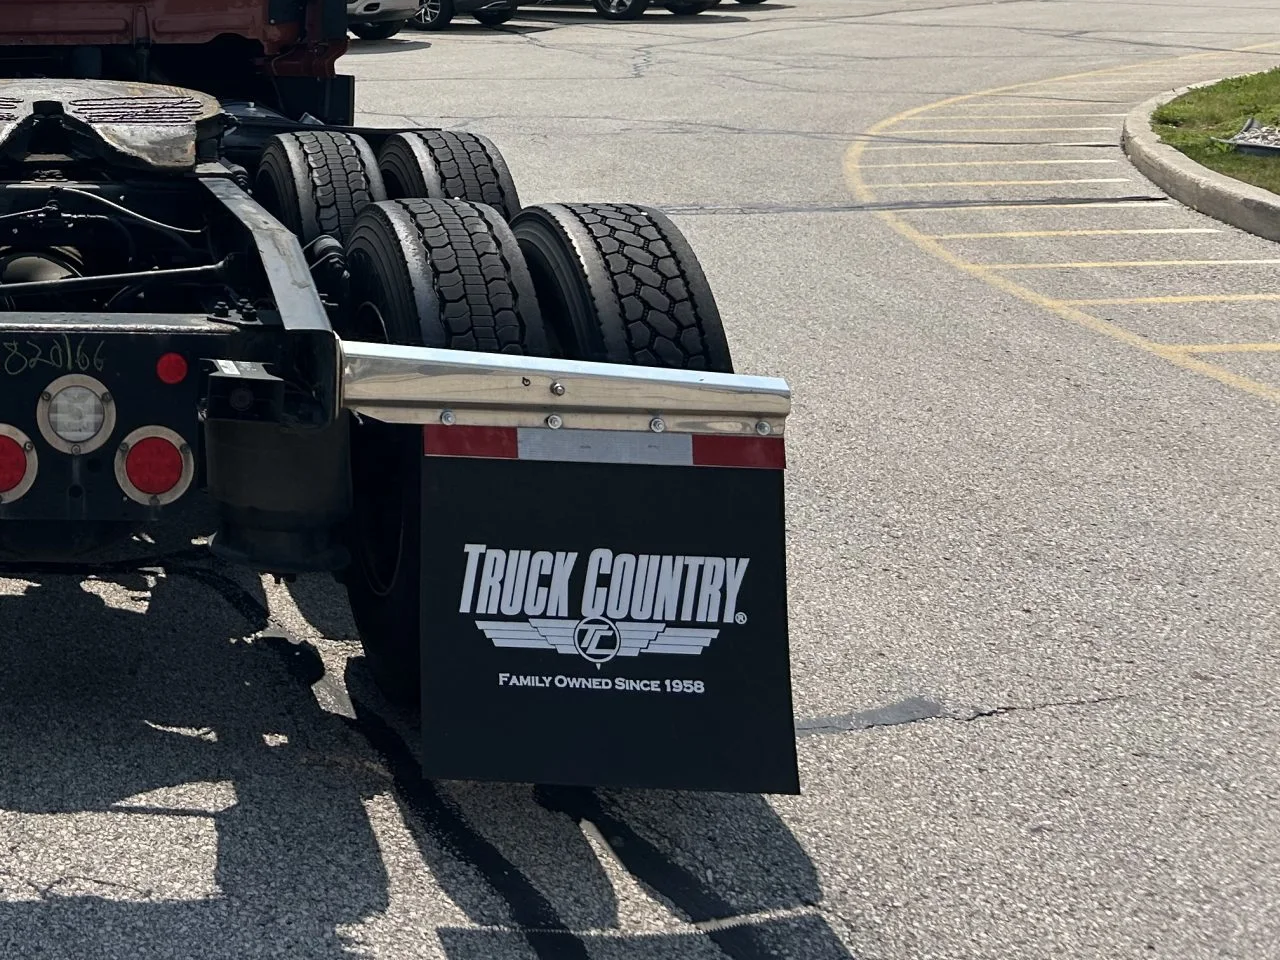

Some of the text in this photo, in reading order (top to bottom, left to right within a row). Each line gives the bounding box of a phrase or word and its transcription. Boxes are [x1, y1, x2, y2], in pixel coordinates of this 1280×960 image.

[459, 543, 578, 617] TRUCK
[499, 673, 705, 693] FAMILY OWNED SINCE 1958
